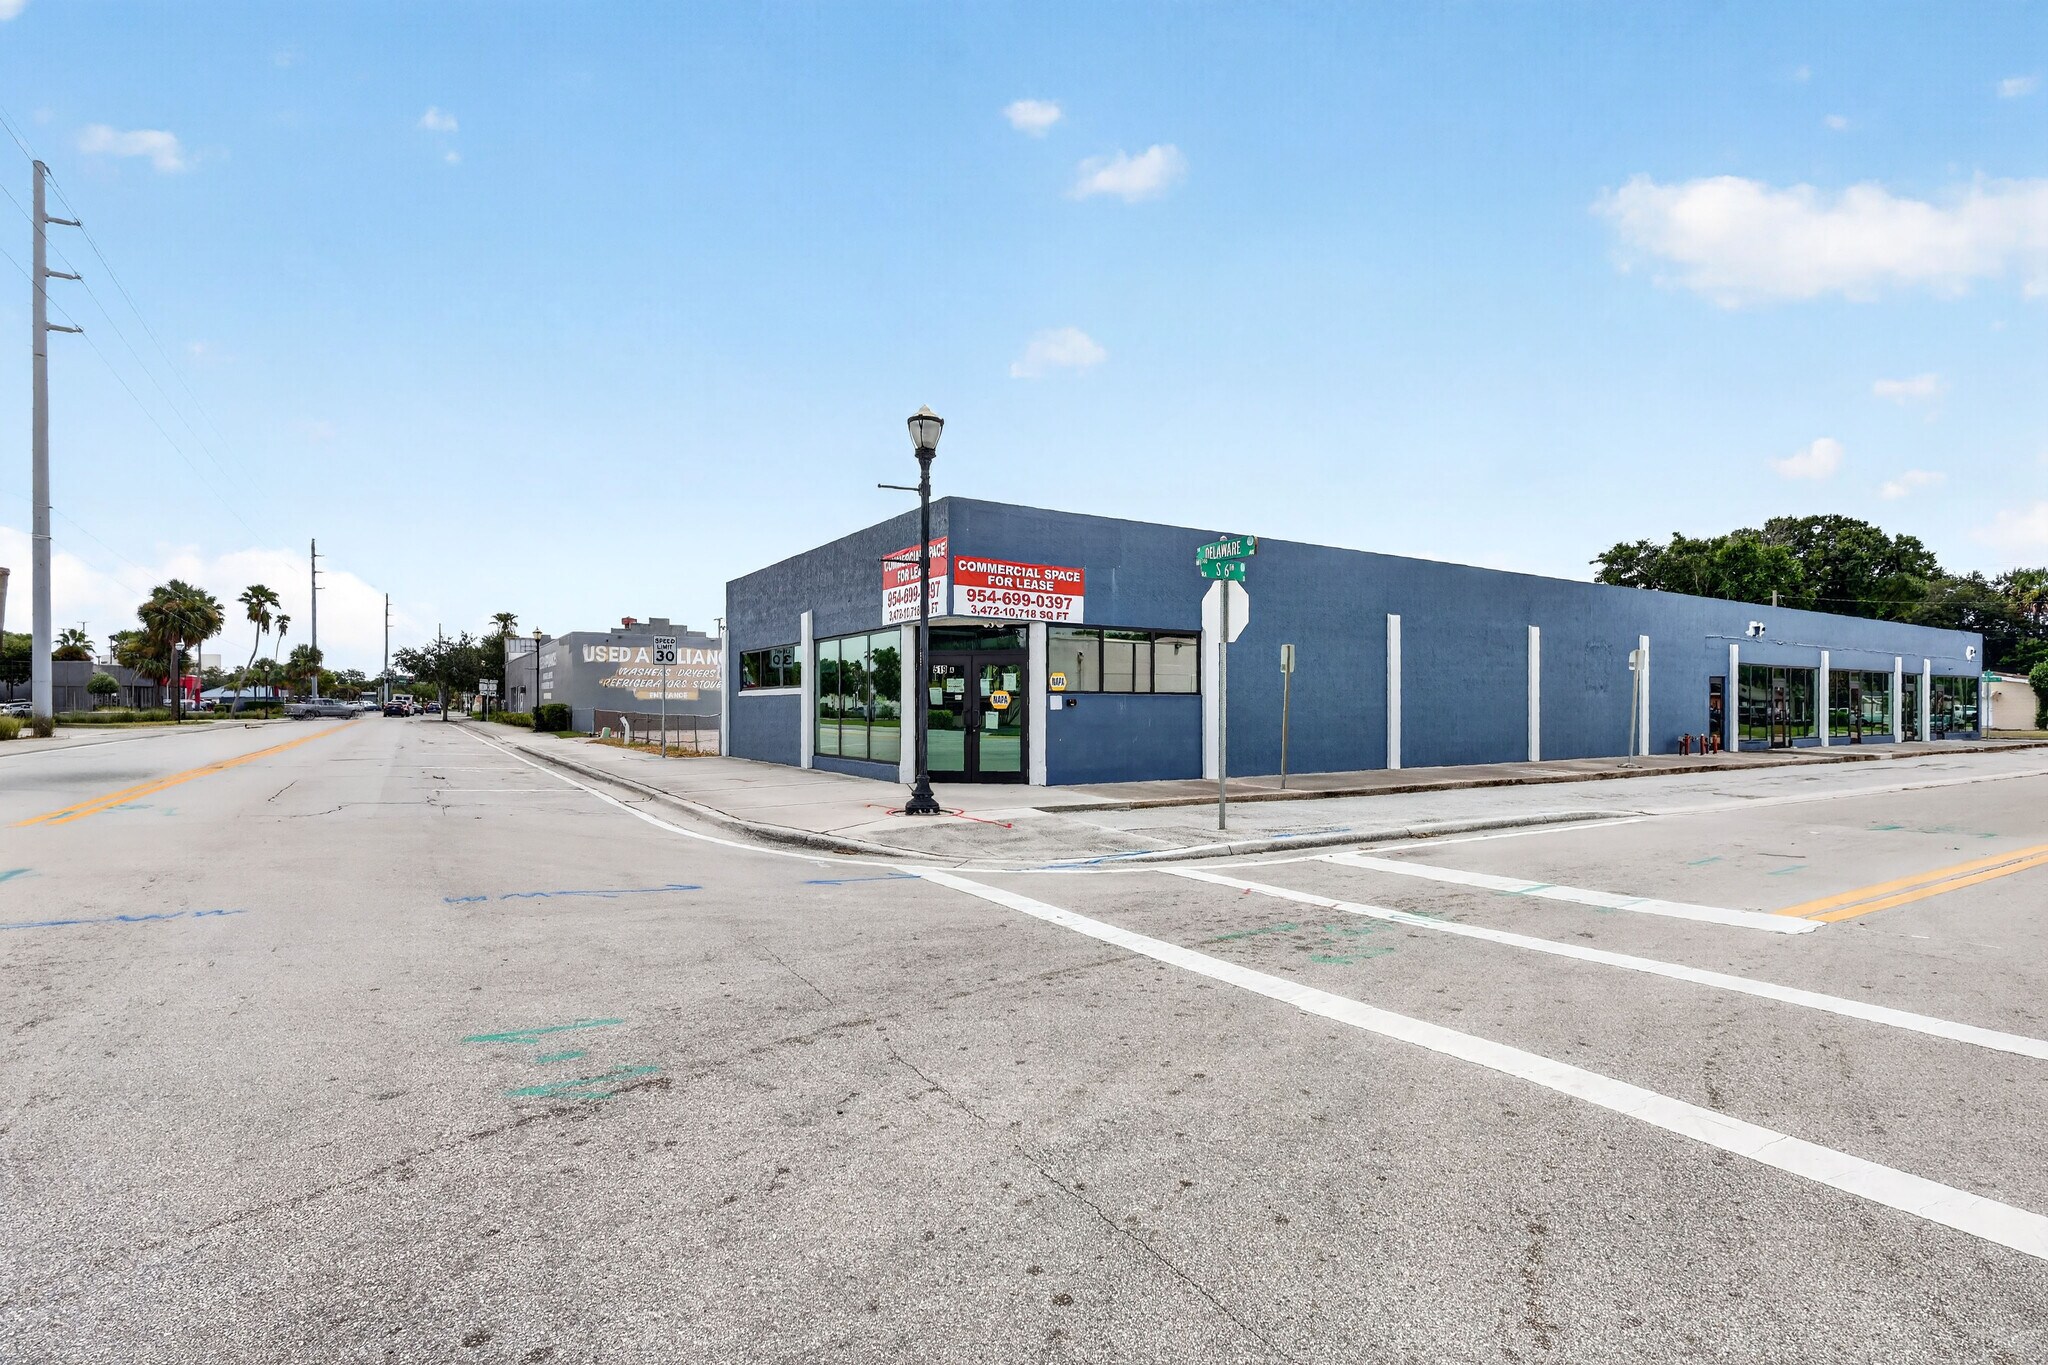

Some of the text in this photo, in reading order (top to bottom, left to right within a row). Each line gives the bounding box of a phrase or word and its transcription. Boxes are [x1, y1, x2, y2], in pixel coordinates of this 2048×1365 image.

[928, 541, 946, 559] PACE
[1205, 541, 1241, 559] DELAWARE
[897, 568, 910, 584] FOR
[958, 559, 1081, 582] COMMERCIAL SPACE
[1216, 562, 1221, 577] S
[987, 575, 1054, 591] FOR LEASE
[966, 588, 1072, 610] 954-699-0397
[970, 604, 1069, 620] 3,472-10,718 SQ FT
[583, 644, 631, 663] USED
[655, 650, 675, 662] 30
[617, 667, 716, 677] WASHERS DRYERS
[933, 665, 948, 674] 519
